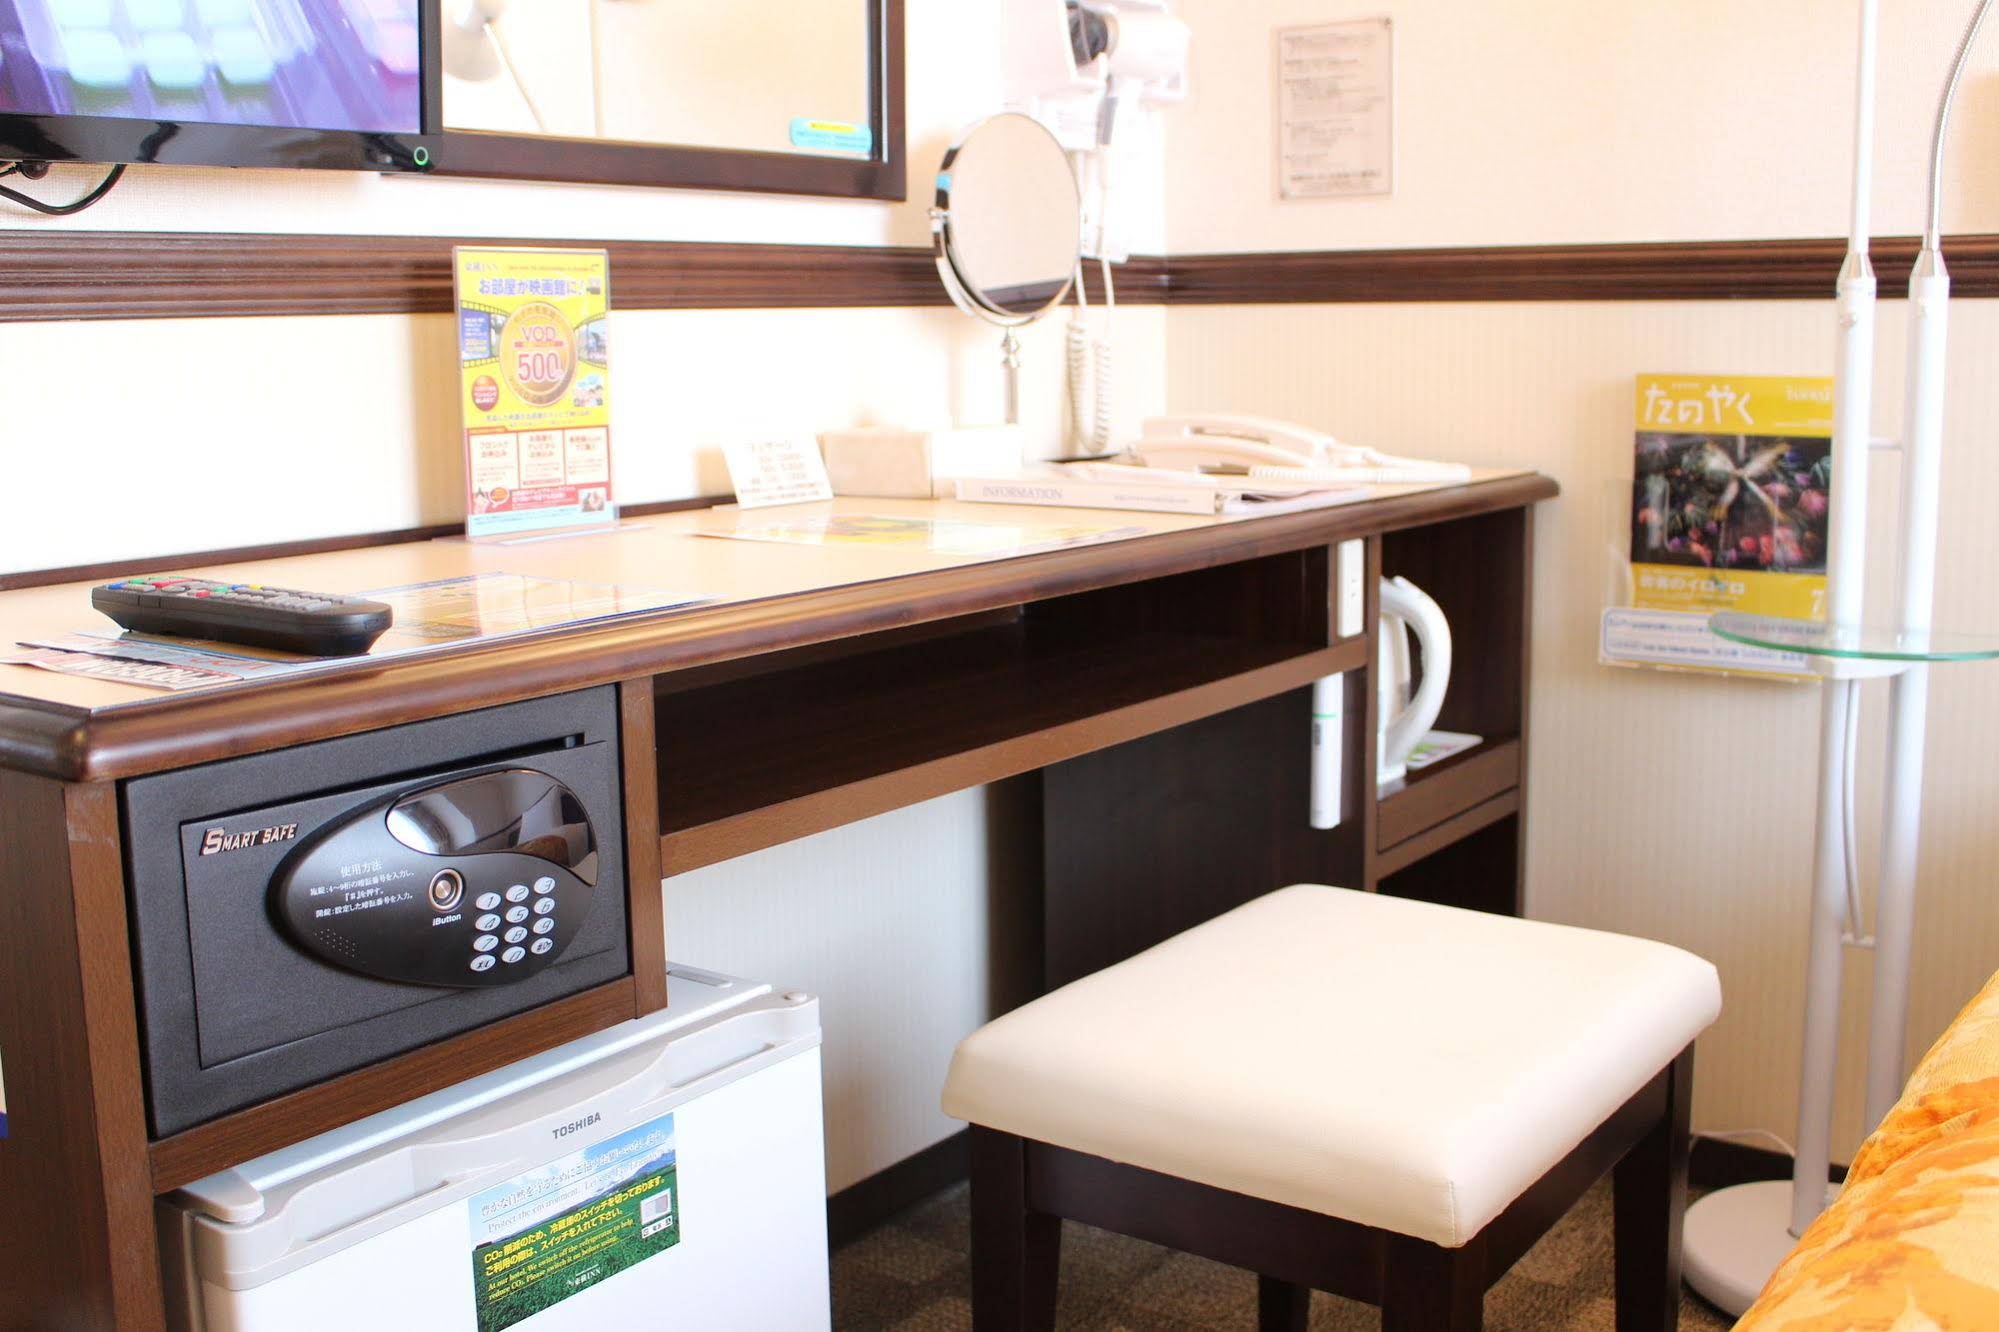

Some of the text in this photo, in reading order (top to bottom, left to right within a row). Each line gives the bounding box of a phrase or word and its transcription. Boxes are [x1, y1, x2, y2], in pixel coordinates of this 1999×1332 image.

[521, 326, 556, 343] VOD
[1644, 383, 1755, 425] たのやく
[982, 486, 1063, 500] INFORMATION
[202, 823, 297, 856] SMART SAFE
[340, 860, 382, 878] 使用方法
[515, 888, 526, 900] 2
[542, 880, 552, 892] 3
[432, 914, 462, 926] iButton
[485, 900, 552, 928] 4 5 6
[482, 938, 494, 950] 7
[539, 920, 551, 932] 9
[552, 1112, 601, 1139] TOSHIBA
